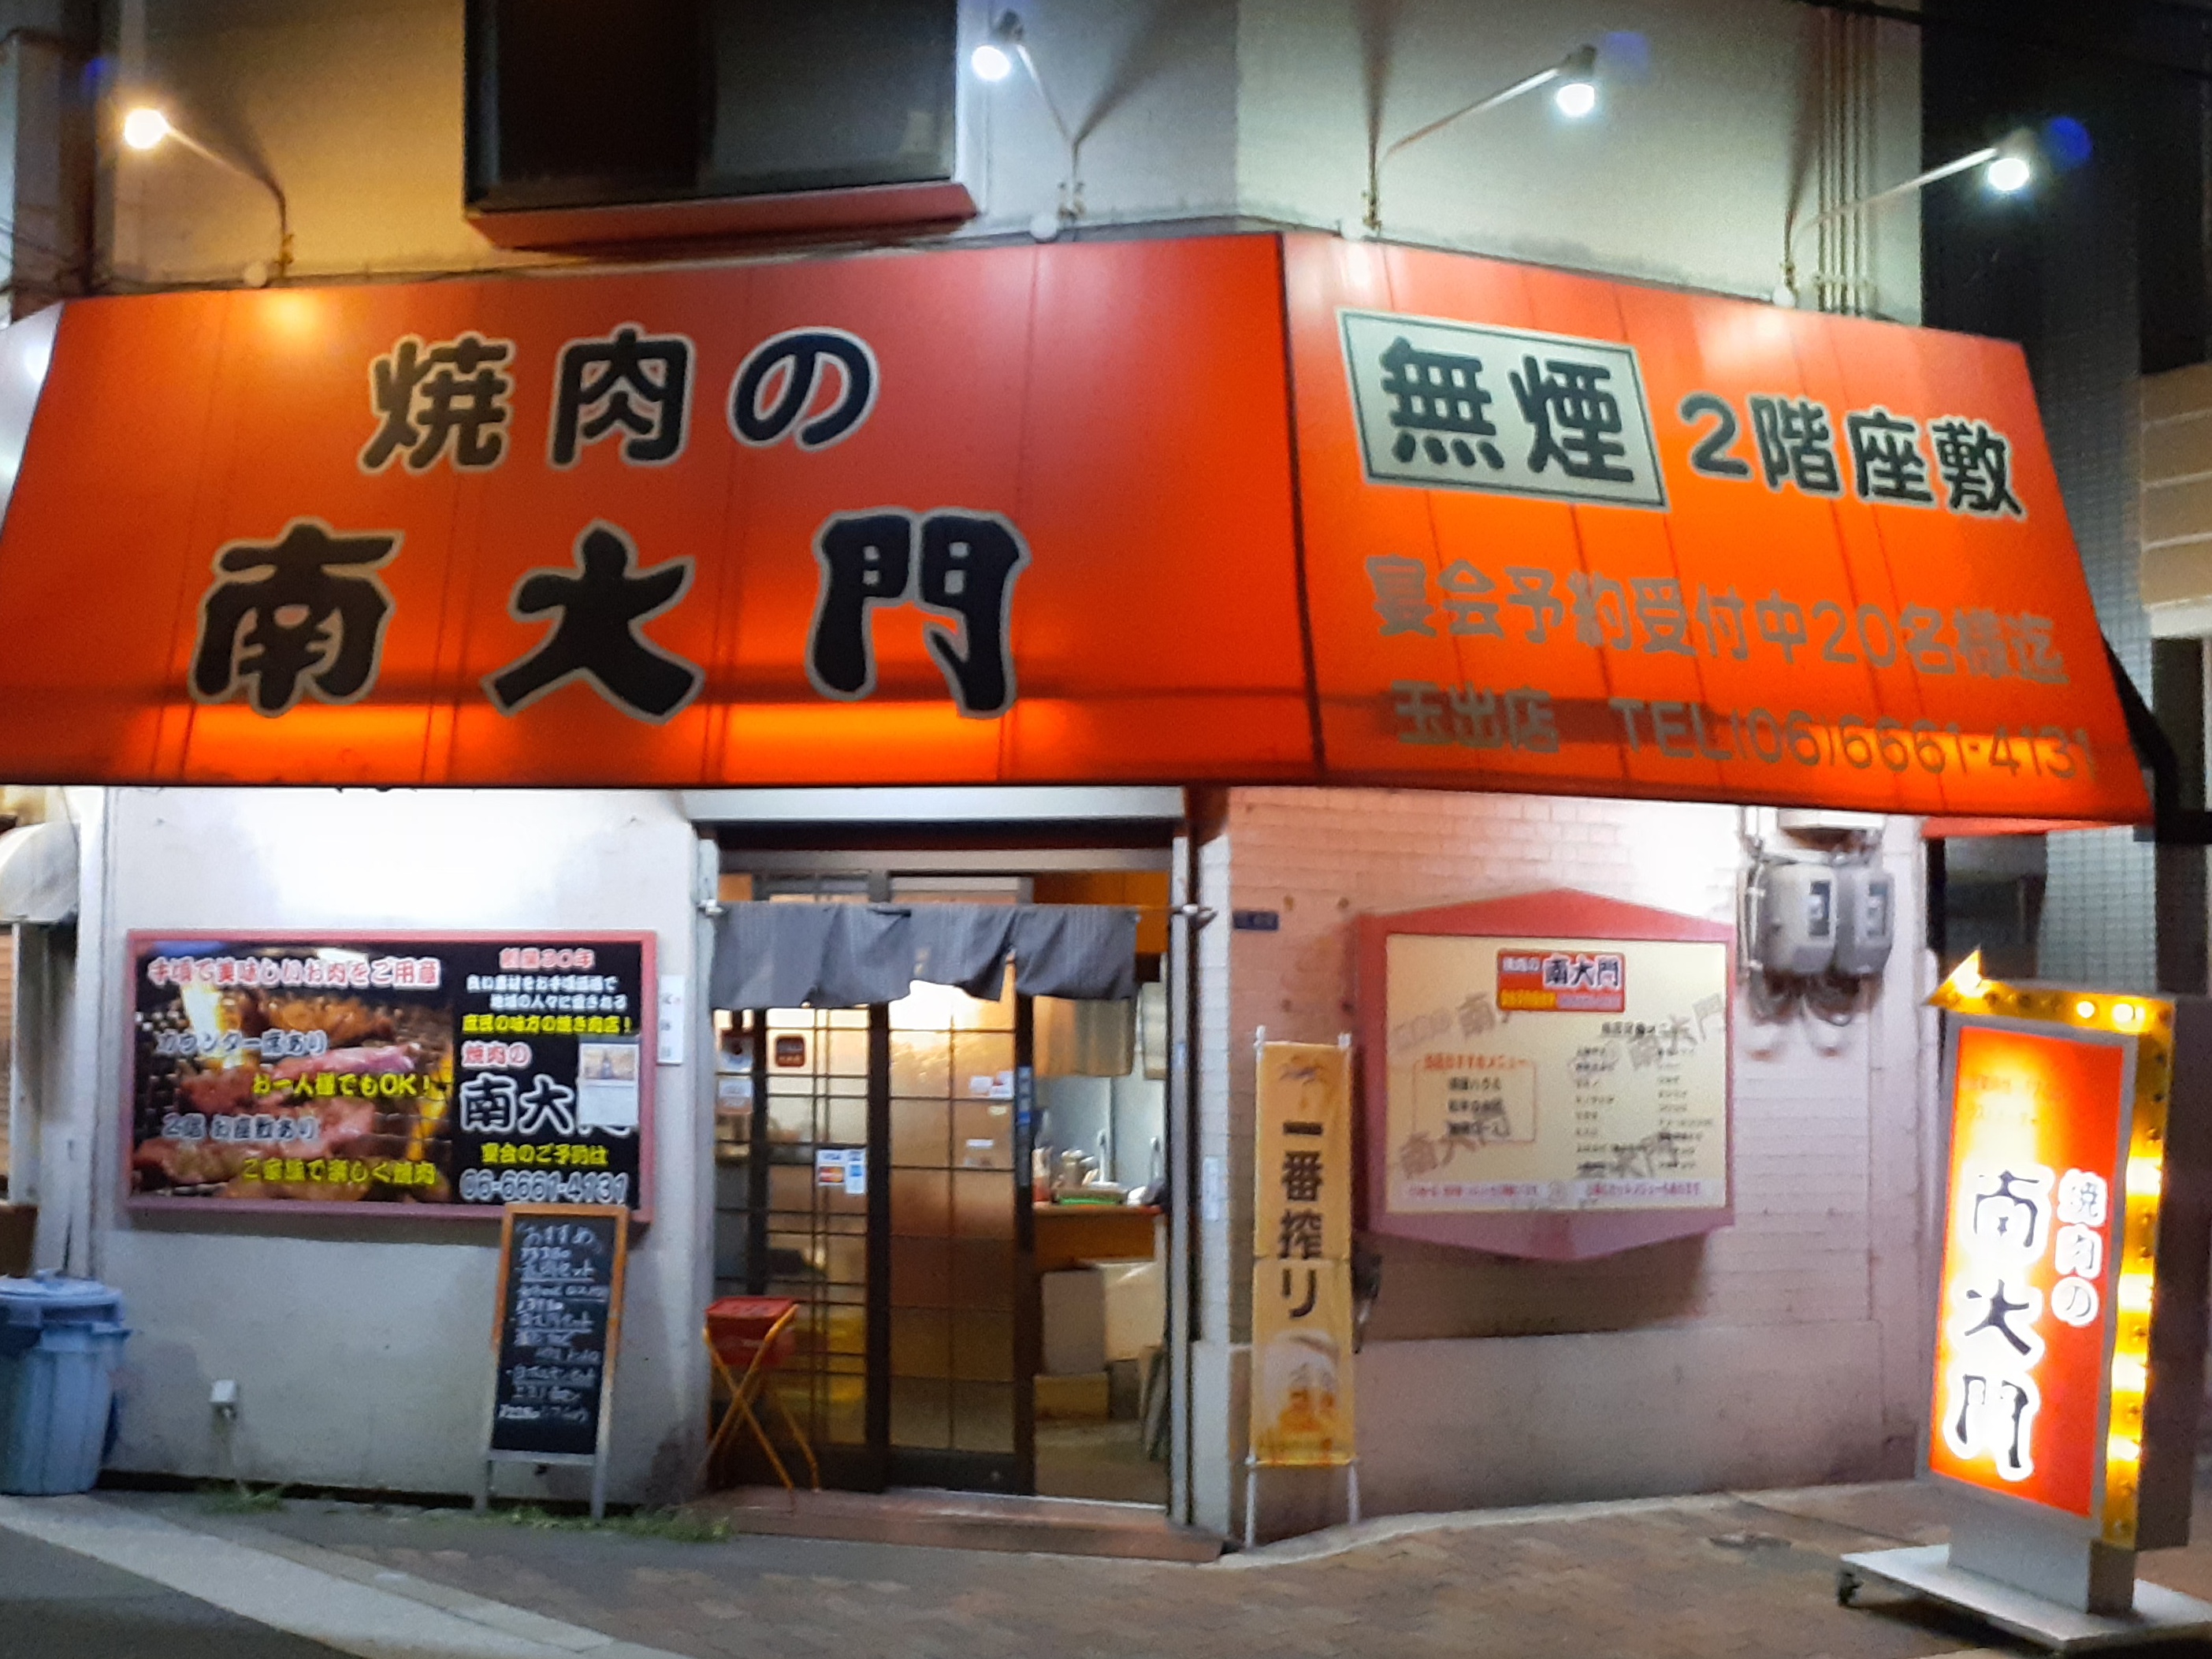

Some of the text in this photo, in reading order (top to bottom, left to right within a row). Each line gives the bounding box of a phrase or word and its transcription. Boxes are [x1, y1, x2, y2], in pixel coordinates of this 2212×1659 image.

[359, 323, 879, 473] 焼肉の
[1379, 336, 1636, 485] 無煙
[1677, 392, 2028, 521] 2階座敷
[187, 505, 1032, 724] 南大門
[1391, 679, 1560, 753] 玉出店
[1543, 953, 1622, 991] 南大門
[461, 1040, 533, 1069] 焼肉の
[459, 1168, 629, 1205] 06-6661-4131
[1277, 1113, 1325, 1319] 一番搾り
[1948, 1166, 2050, 1479] 南大門
